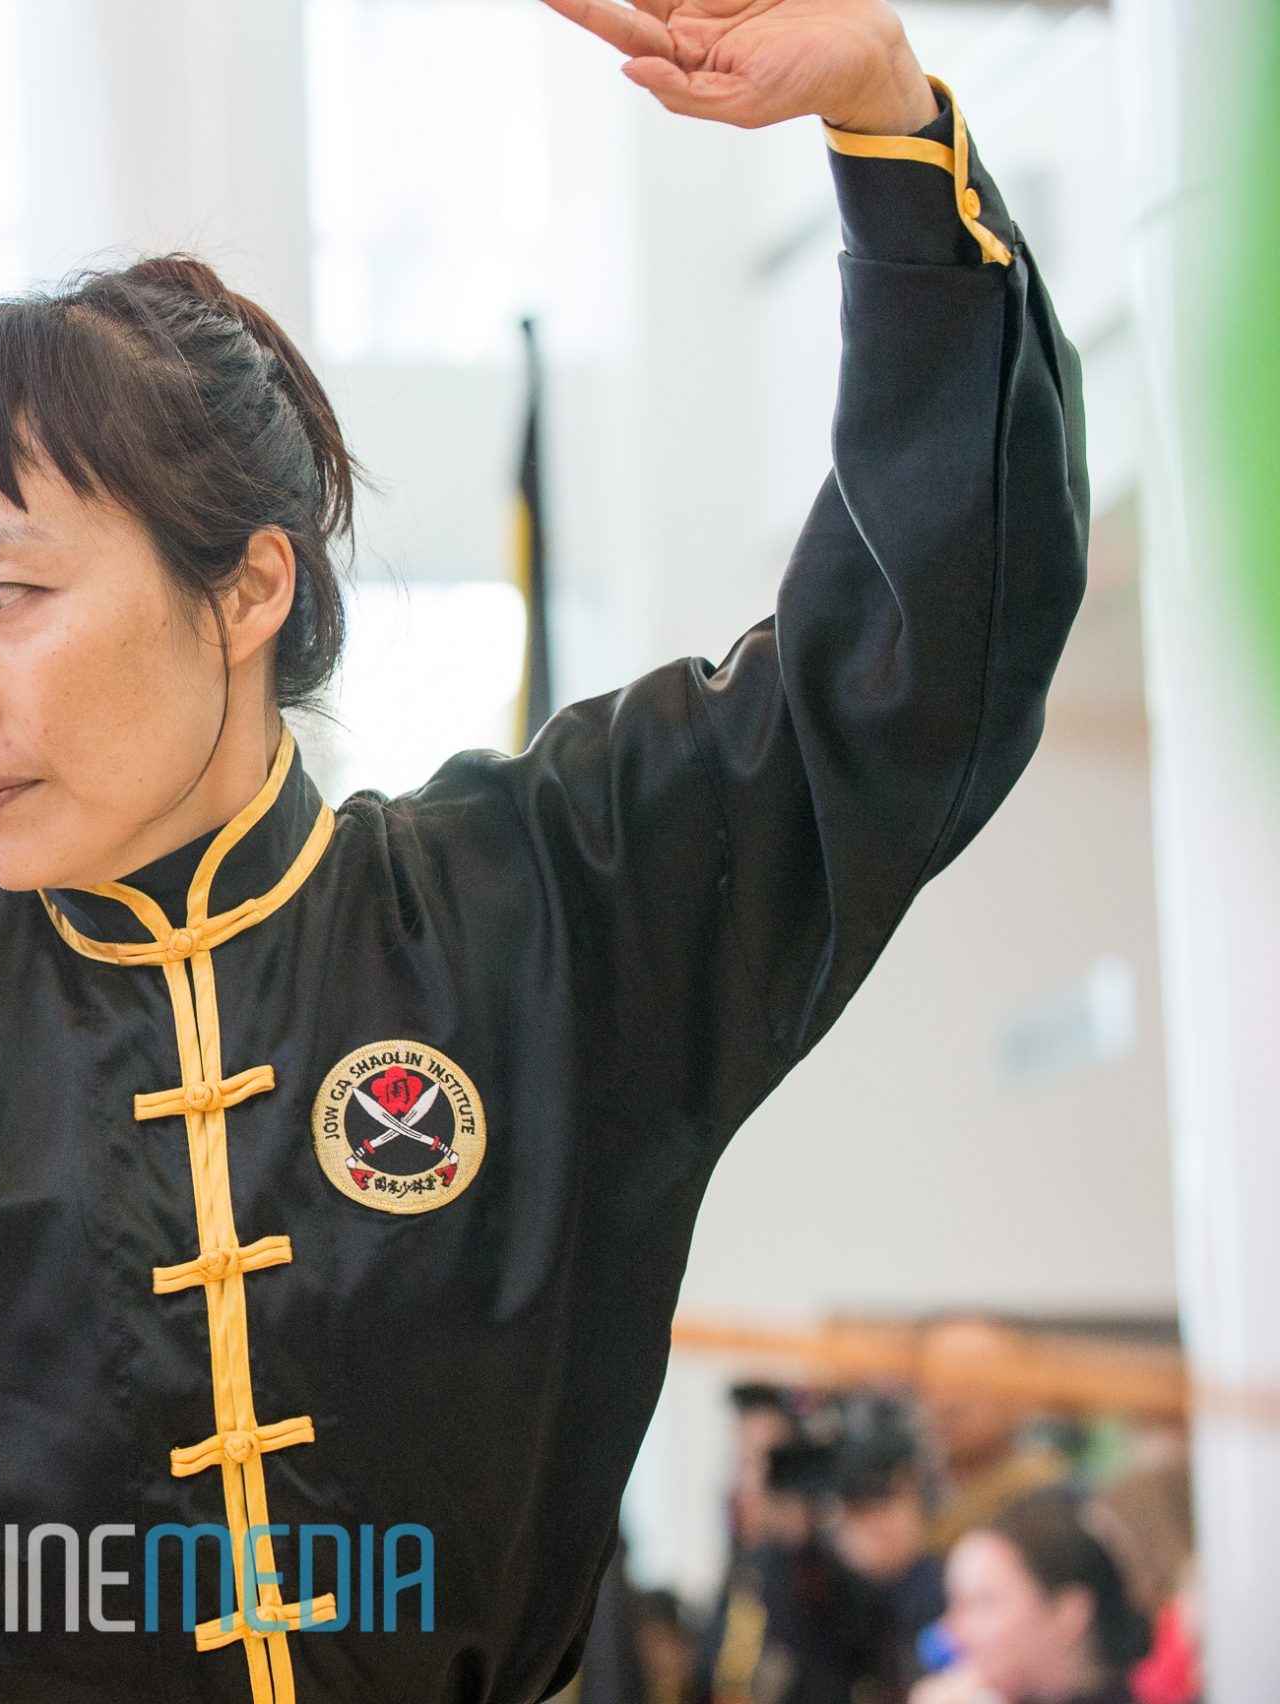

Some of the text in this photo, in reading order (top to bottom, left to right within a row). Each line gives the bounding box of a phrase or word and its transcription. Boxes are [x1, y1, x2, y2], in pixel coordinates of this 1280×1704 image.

[323, 1051, 476, 1140] JOW GA SHAOLIN INSTITUTE
